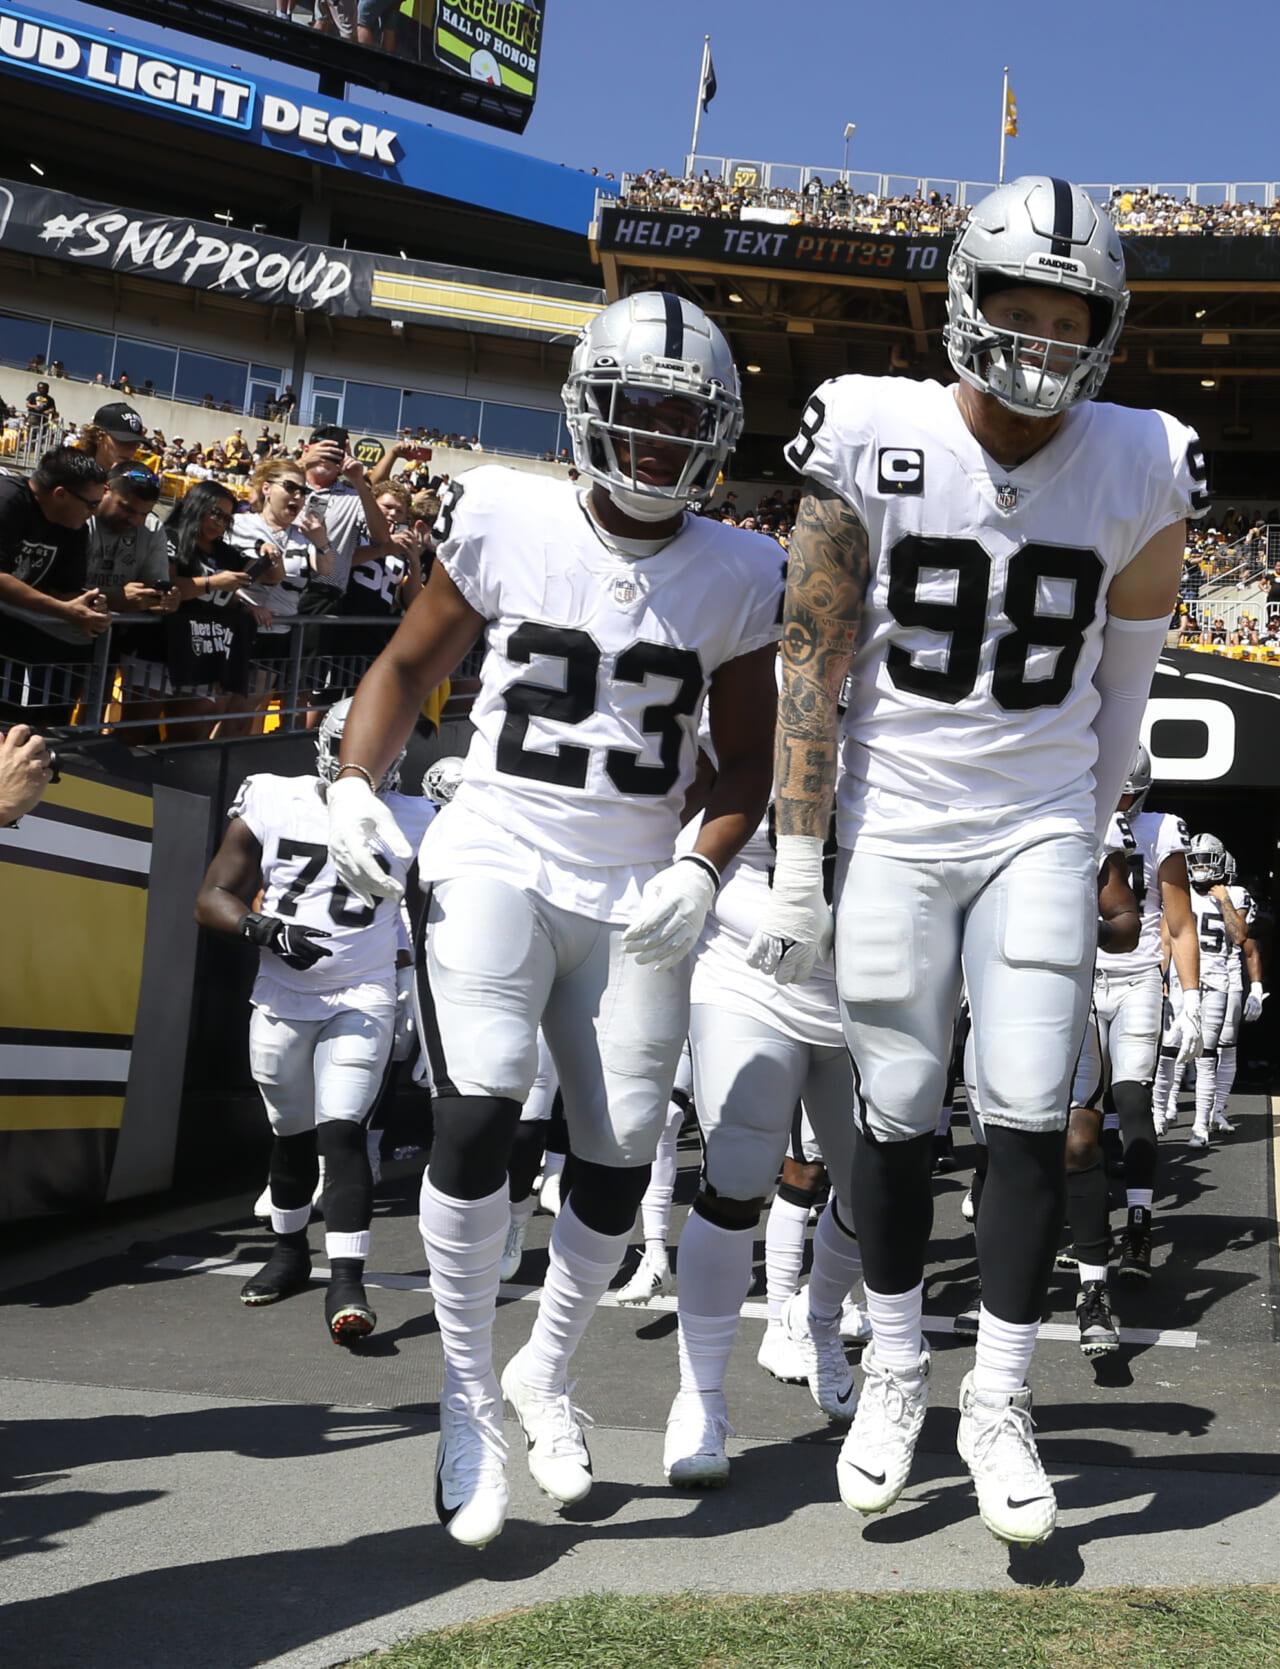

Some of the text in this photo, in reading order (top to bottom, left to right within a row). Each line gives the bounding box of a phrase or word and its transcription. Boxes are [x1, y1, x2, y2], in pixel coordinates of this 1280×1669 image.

[0, 15, 250, 120] UD LIGHT
[443, 6, 536, 73] HALL OF HONOR
[261, 95, 399, 166] DECK
[38, 213, 352, 308] #SNUPROUD
[614, 219, 938, 270] HELP? TEXT PITT33 TO
[1038, 256, 1079, 273] RAIDERS
[357, 444, 382, 464] 227
[880, 450, 921, 481] C
[212, 621, 223, 636] is
[884, 532, 1105, 711] 98
[495, 621, 704, 797] 23
[1192, 912, 1226, 954] 5
